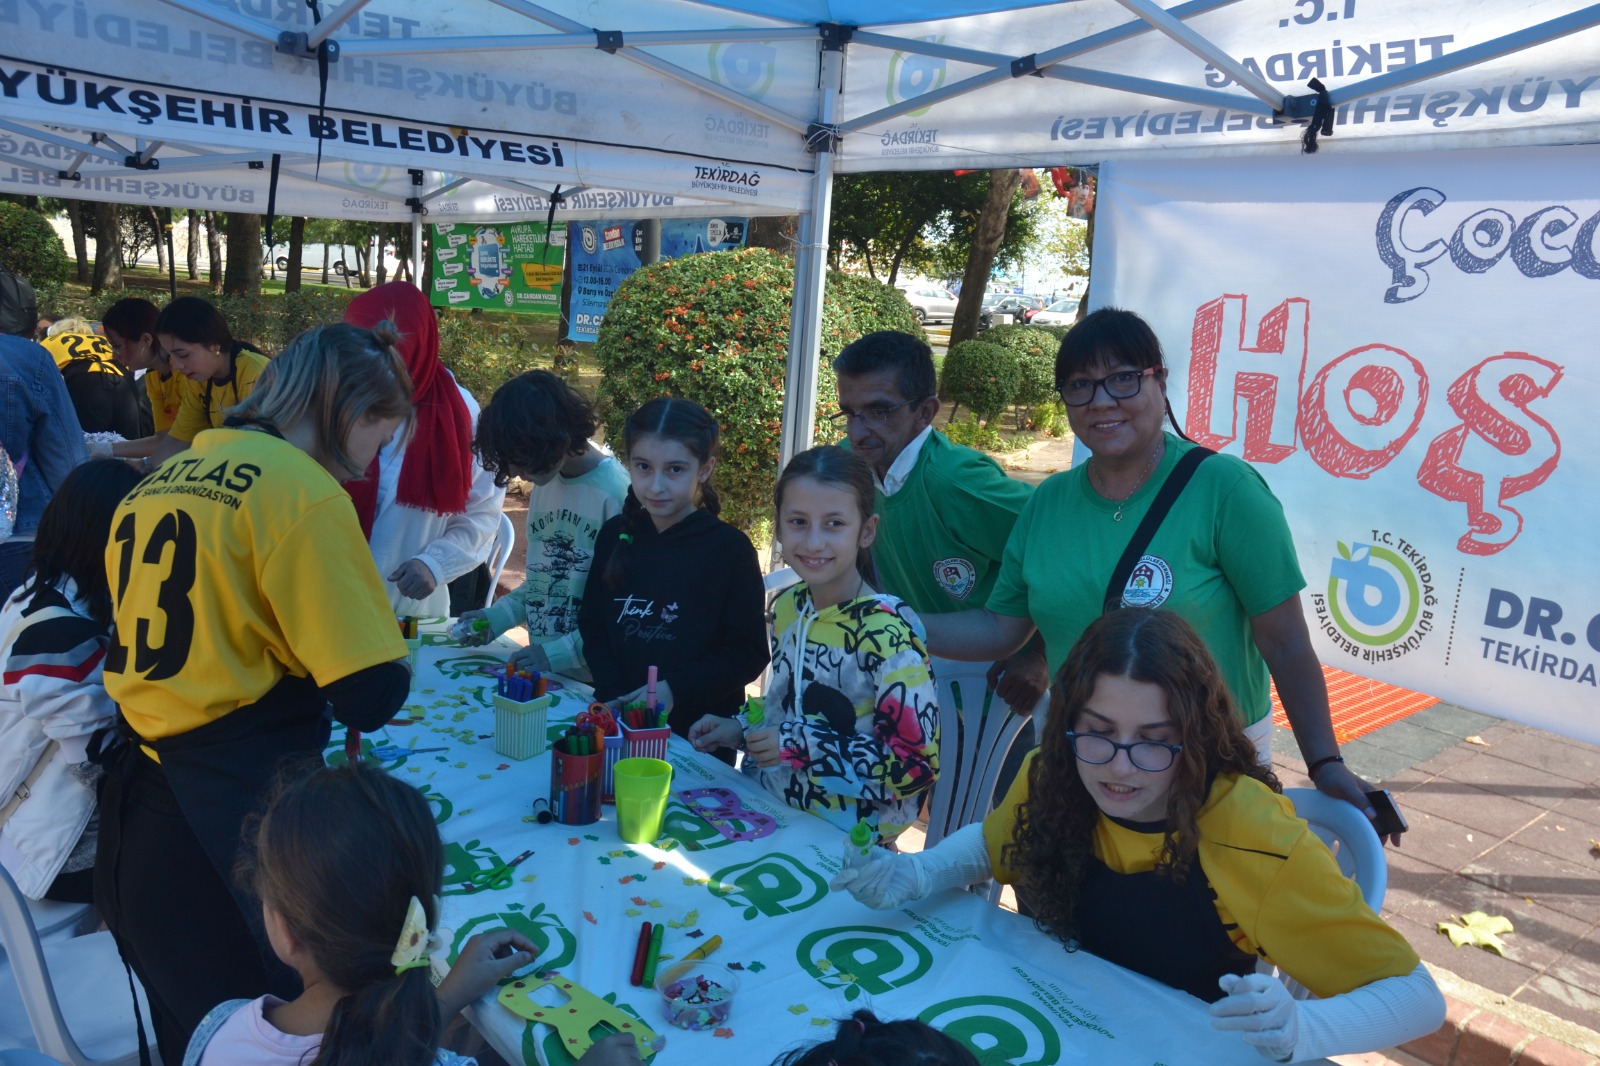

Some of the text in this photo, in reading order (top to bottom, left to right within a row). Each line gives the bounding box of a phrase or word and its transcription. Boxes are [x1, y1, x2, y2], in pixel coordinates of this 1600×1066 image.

[308, 113, 565, 168] BELEDİYESİ
[691, 181, 759, 196] BÜYÜKŞEHİR BELEDİYESİ
[694, 165, 761, 187] TEKİRDAĞ
[152, 458, 262, 494] ATLAS
[170, 484, 242, 511] ORGANİZASYON
[103, 509, 198, 682] 13
[613, 594, 654, 624] Think
[1310, 529, 1439, 666] T.C. TEKİRDAĞ BÜYÜKŞEHİR BELEDİYESİ
[1011, 966, 1061, 1006] BELEDİYESİ
